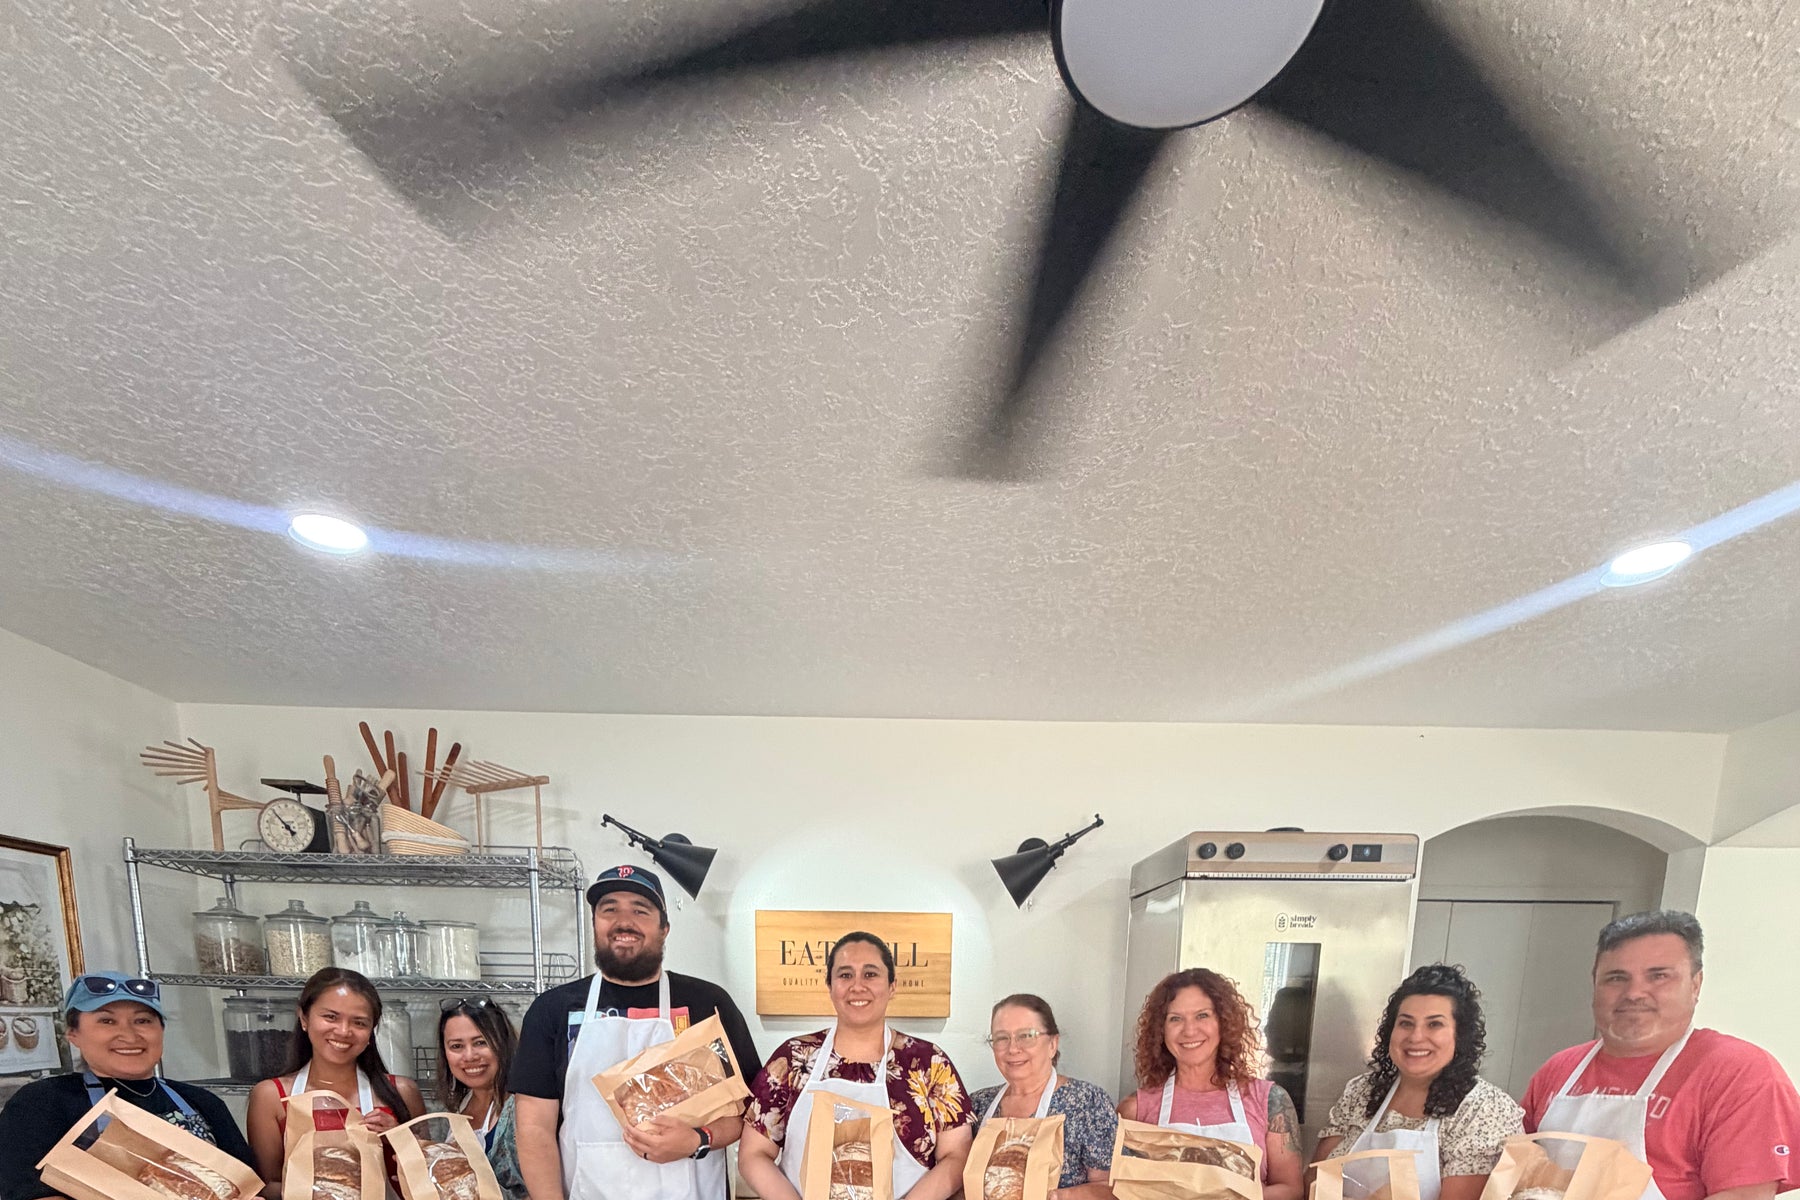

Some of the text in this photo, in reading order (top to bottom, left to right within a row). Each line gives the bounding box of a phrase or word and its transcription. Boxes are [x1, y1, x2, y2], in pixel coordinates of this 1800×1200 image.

[1290, 914, 1318, 924] simply
[779, 940, 836, 966] EAT
[783, 977, 818, 986] QUALITY
